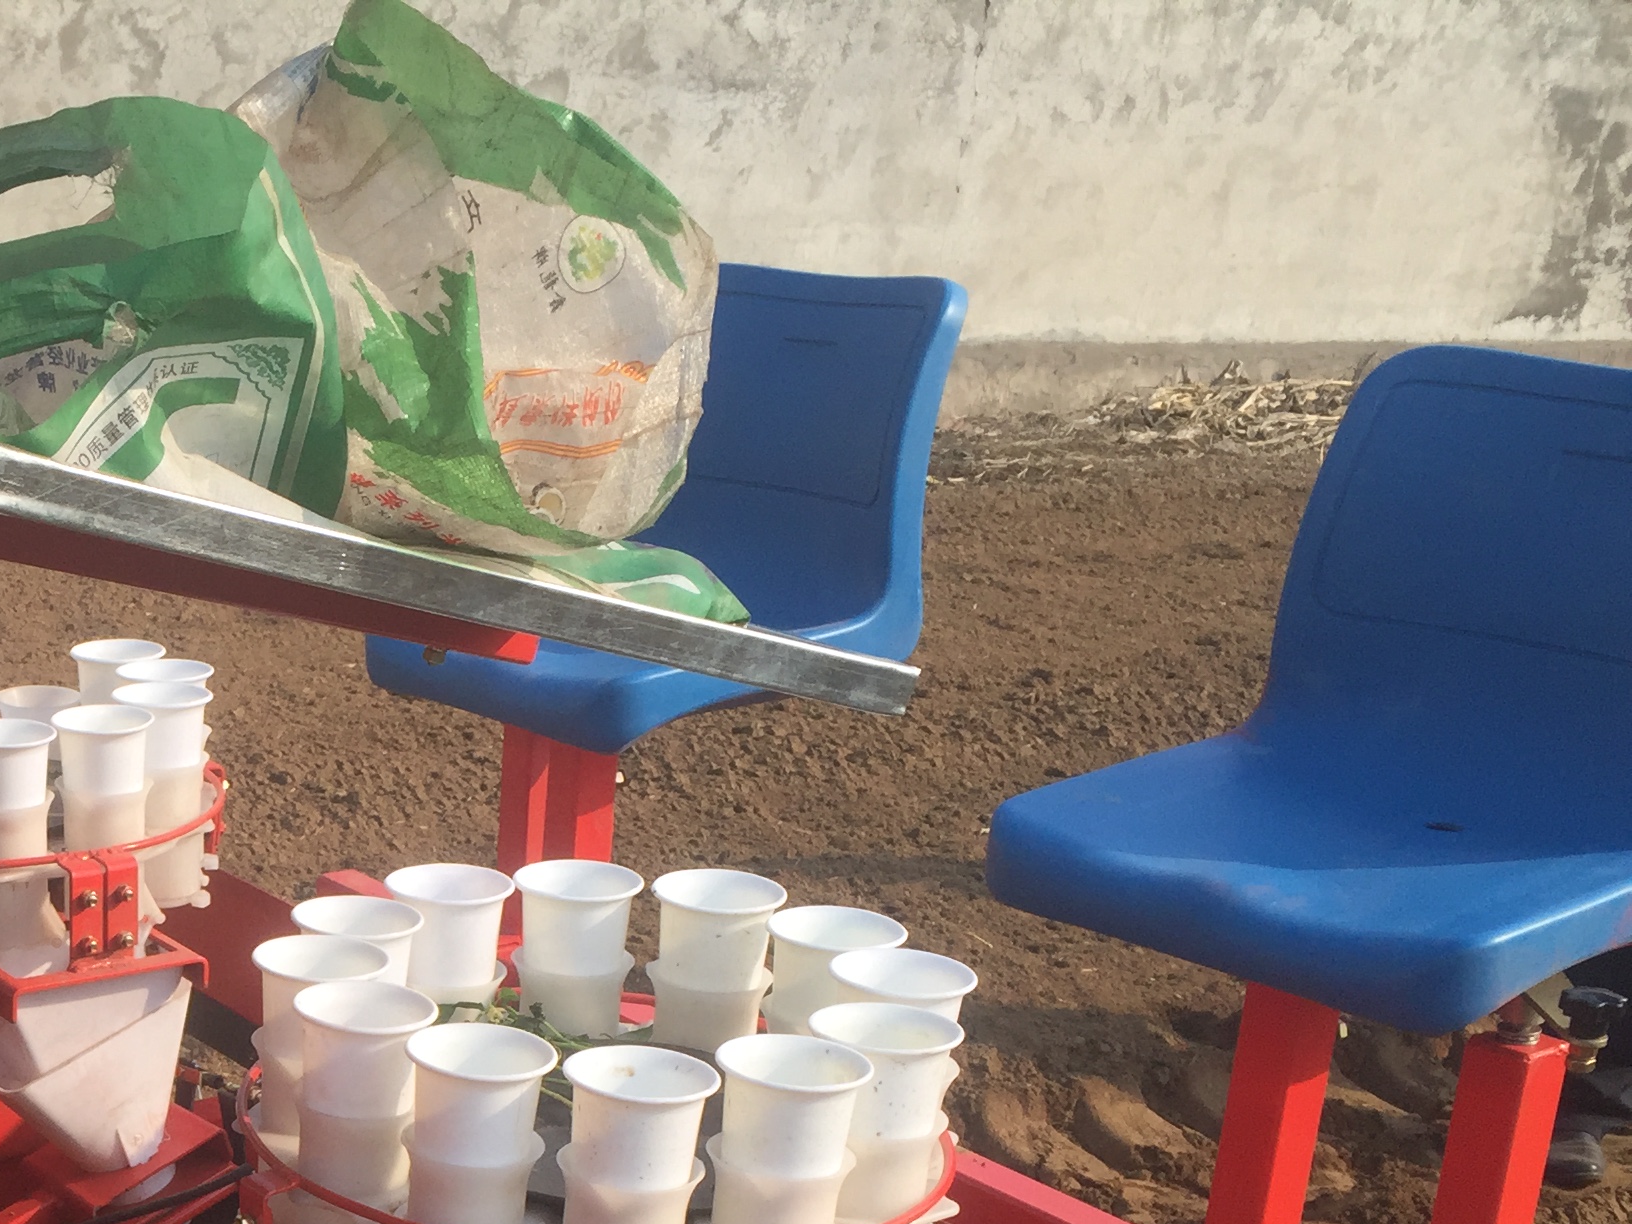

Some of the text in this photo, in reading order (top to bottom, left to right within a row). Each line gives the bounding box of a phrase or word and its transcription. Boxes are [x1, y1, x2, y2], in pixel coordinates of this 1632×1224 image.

[71, 360, 199, 469] 0质量管理体系认证
